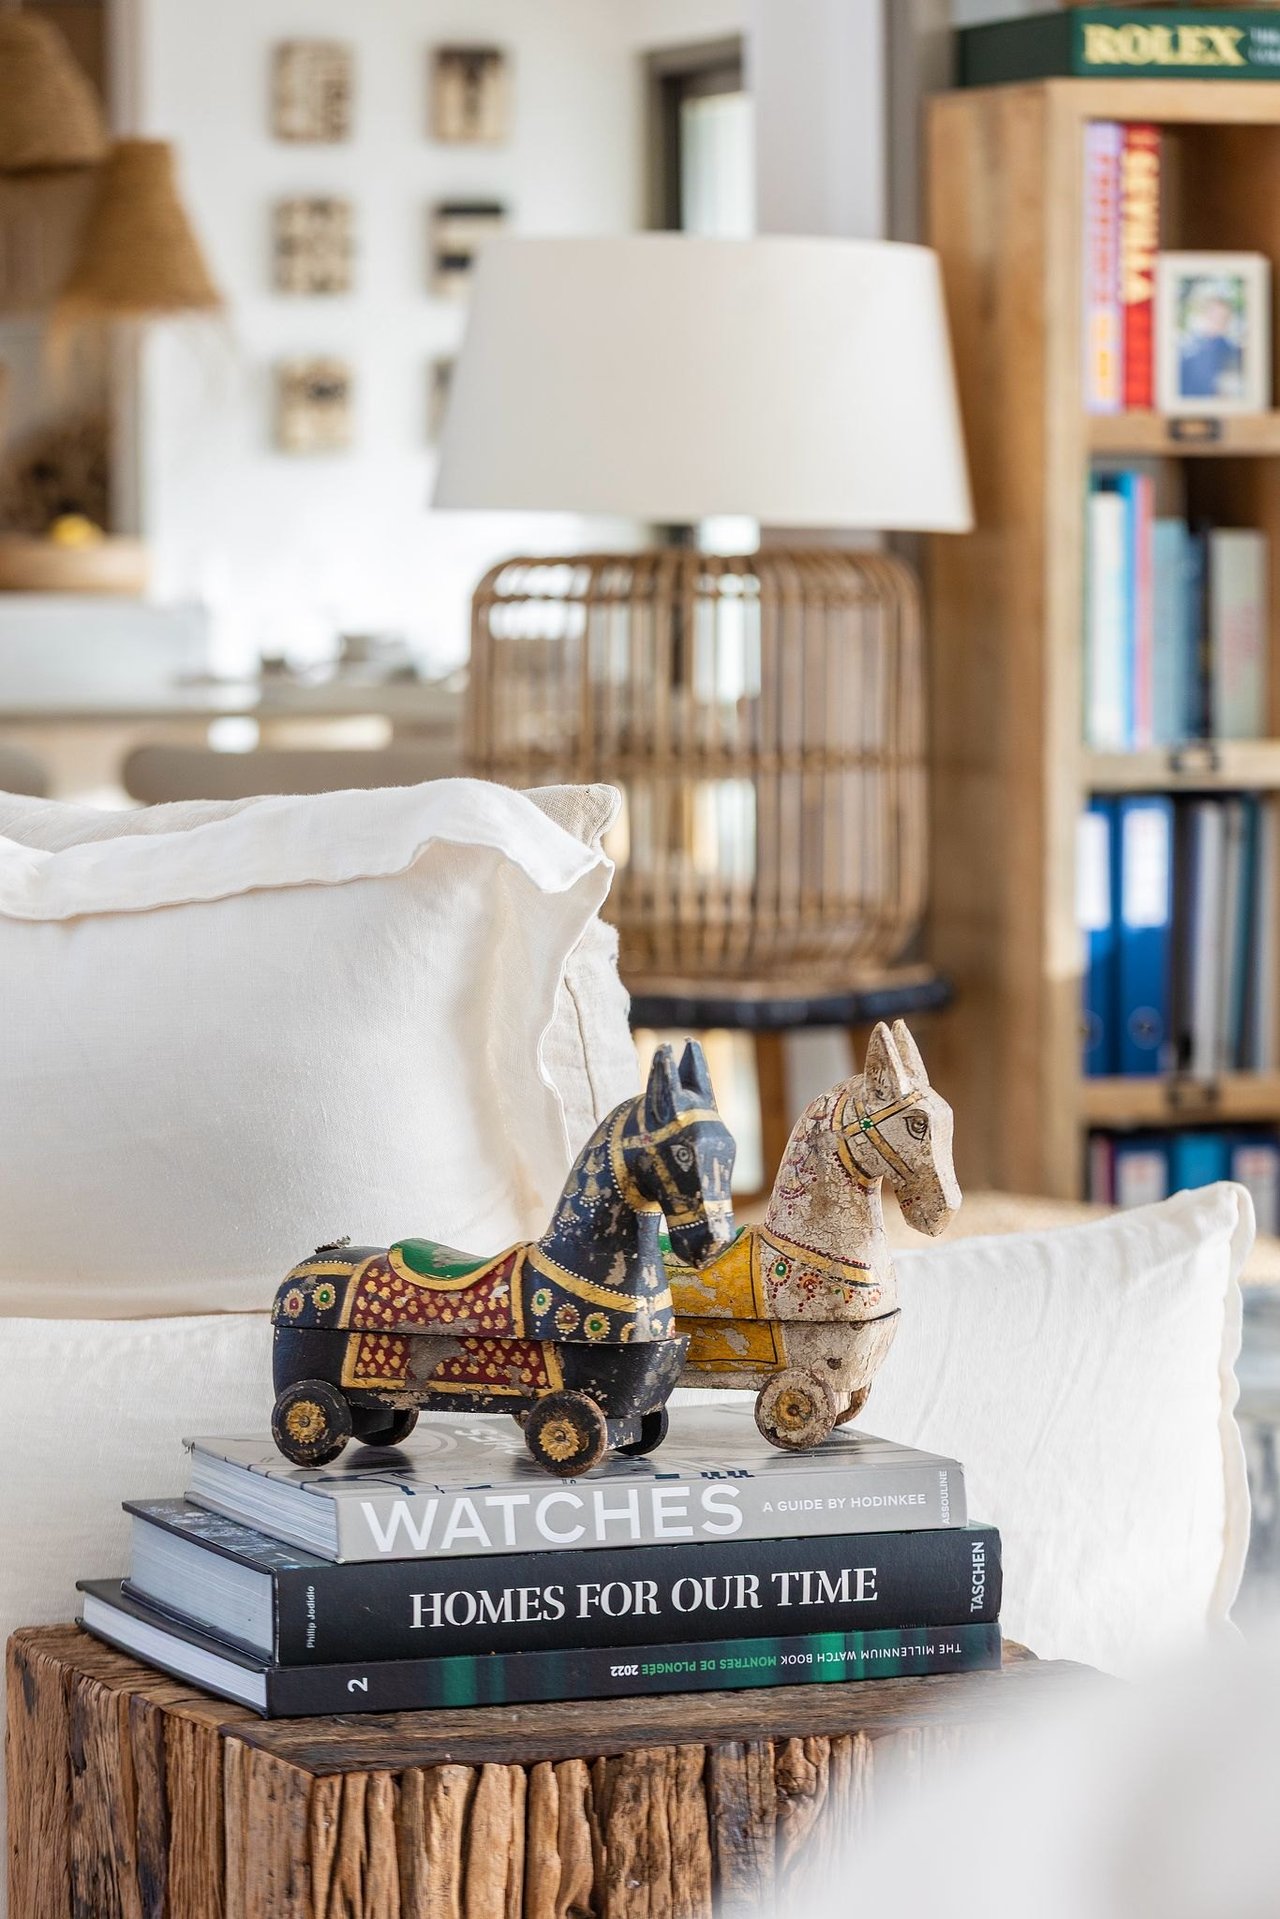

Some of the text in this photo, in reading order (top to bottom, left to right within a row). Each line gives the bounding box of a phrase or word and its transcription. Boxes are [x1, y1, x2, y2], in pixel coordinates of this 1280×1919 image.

[1083, 23, 1249, 66] ROLEX
[360, 1484, 743, 1553] WATCHES
[763, 1493, 926, 1513] A GUIDE BY HODINKEE
[939, 1470, 951, 1525] ASSOULINE
[409, 1567, 878, 1629] HOMES FOR OUR TIME
[970, 1541, 985, 1613] TASCHEN
[306, 1585, 317, 1649] Philip Jodidio
[346, 1677, 368, 1693] 2
[610, 1643, 961, 1677] THE MILLENNIUM WATCH BOOK MONTRES DE PLONGÉE 2022
